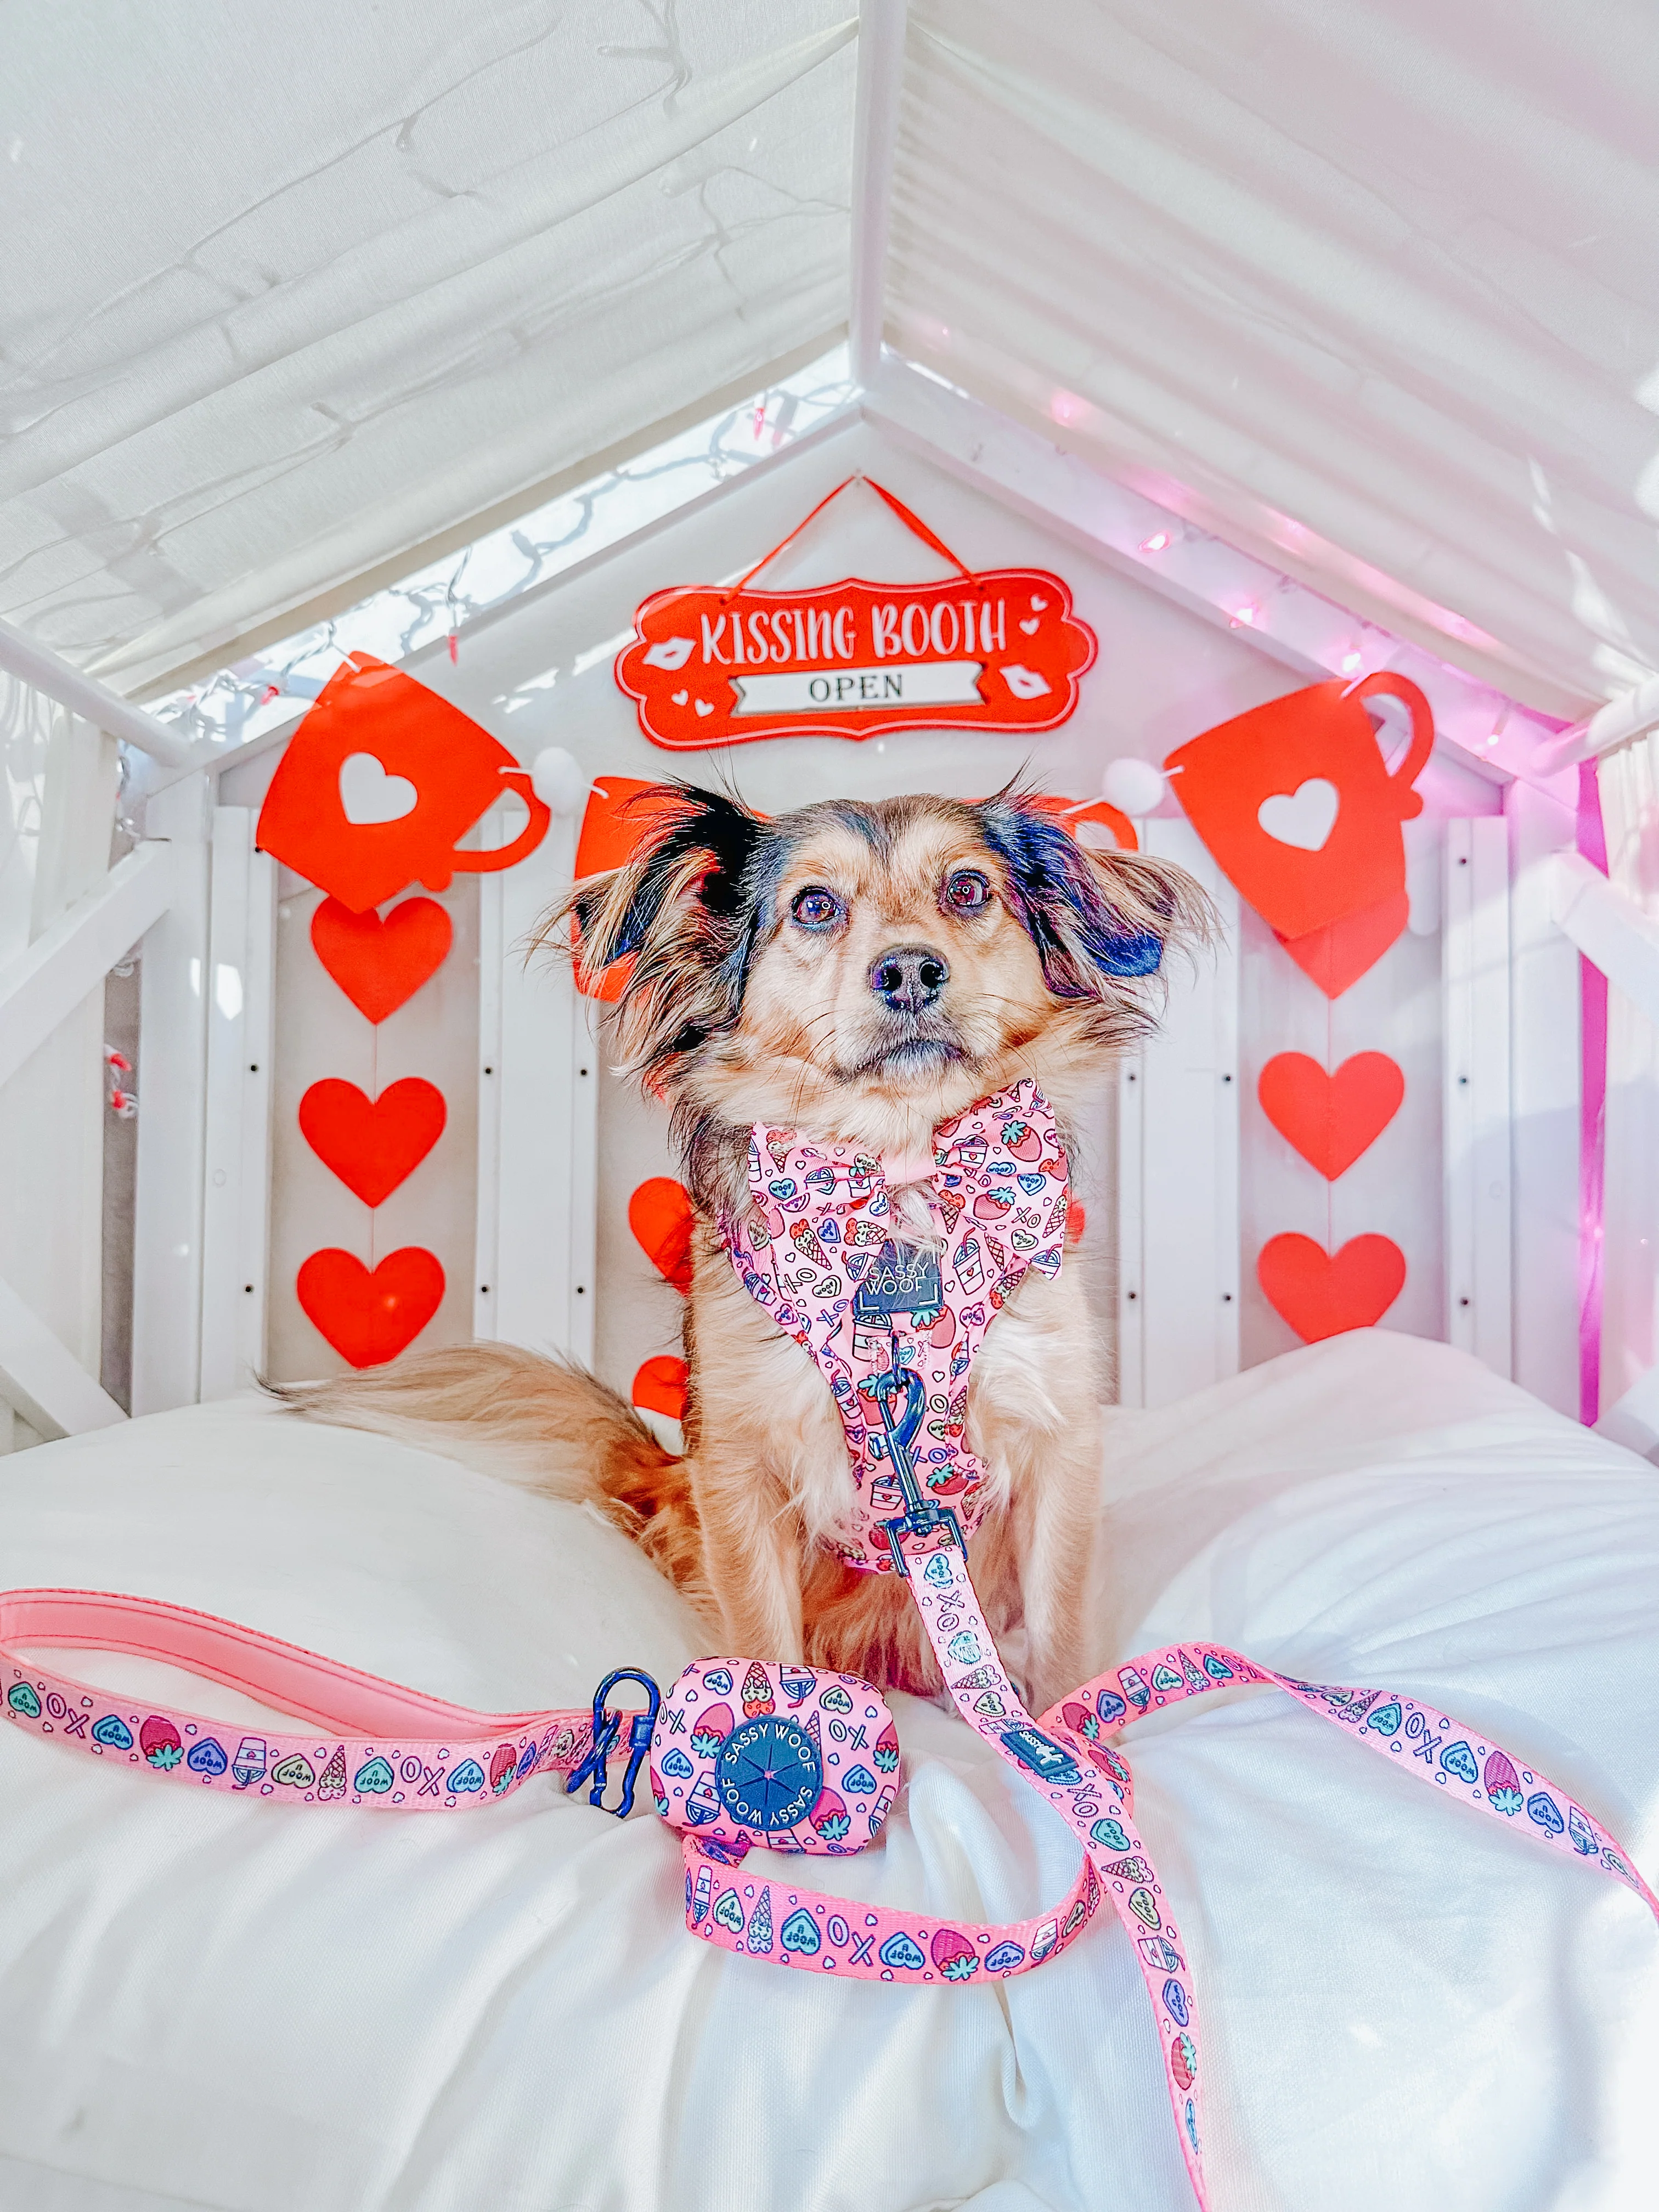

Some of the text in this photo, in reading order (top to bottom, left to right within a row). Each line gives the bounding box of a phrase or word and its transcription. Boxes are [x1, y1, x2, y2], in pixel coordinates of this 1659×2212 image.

[701, 597, 1006, 665] KISSING BOOTH
[810, 674, 903, 702] OPEN
[866, 1276, 926, 1295] WOOF
[869, 1262, 928, 1282] SASSY
[725, 1723, 816, 1772] SASSY WOOF
[359, 1778, 389, 1786] WOOF
[721, 1778, 812, 1826] SASSY WOOF
